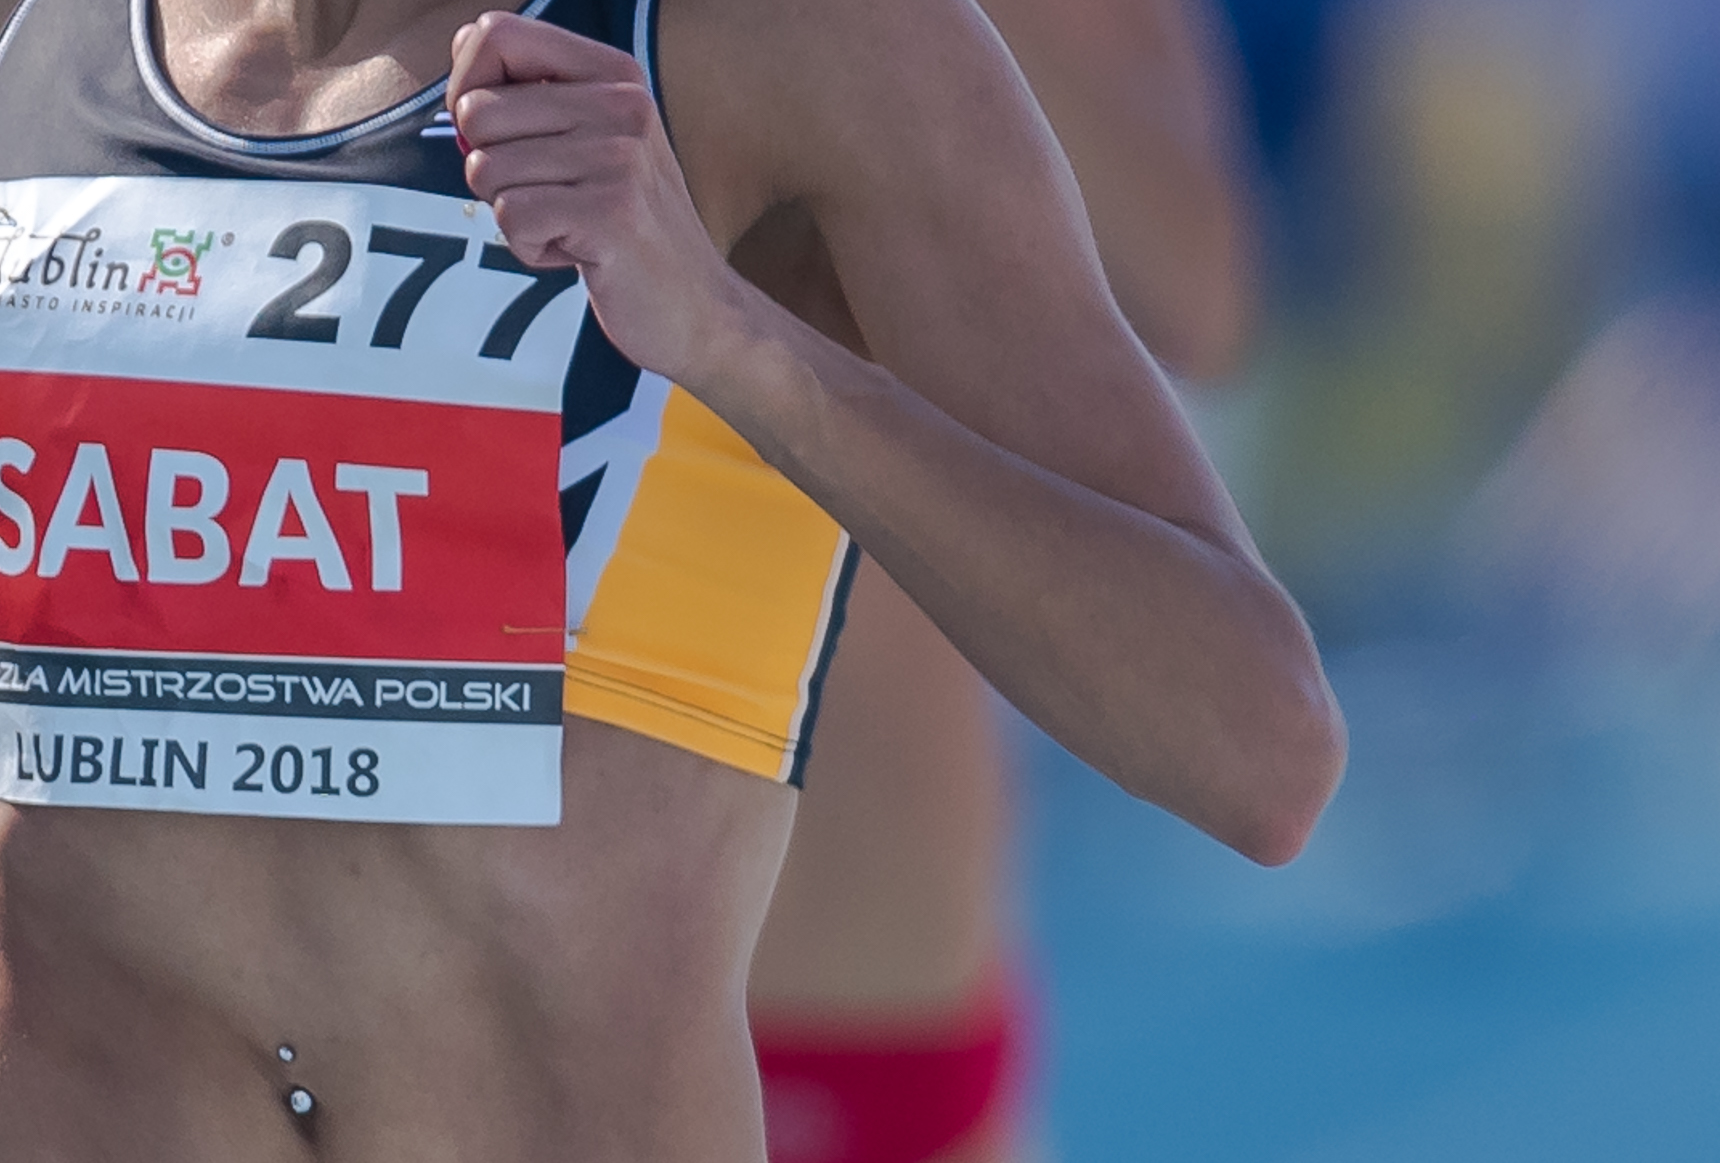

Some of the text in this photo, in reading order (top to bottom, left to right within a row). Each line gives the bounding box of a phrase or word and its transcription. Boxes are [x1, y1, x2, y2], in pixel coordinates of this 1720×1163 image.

[73, 299, 196, 322] INSPIRACJI
[247, 219, 580, 360] 277
[57, 666, 364, 708] MISTRZOSTWA
[376, 679, 532, 712] POLSKI
[16, 731, 381, 799] LUBLIN 2018
